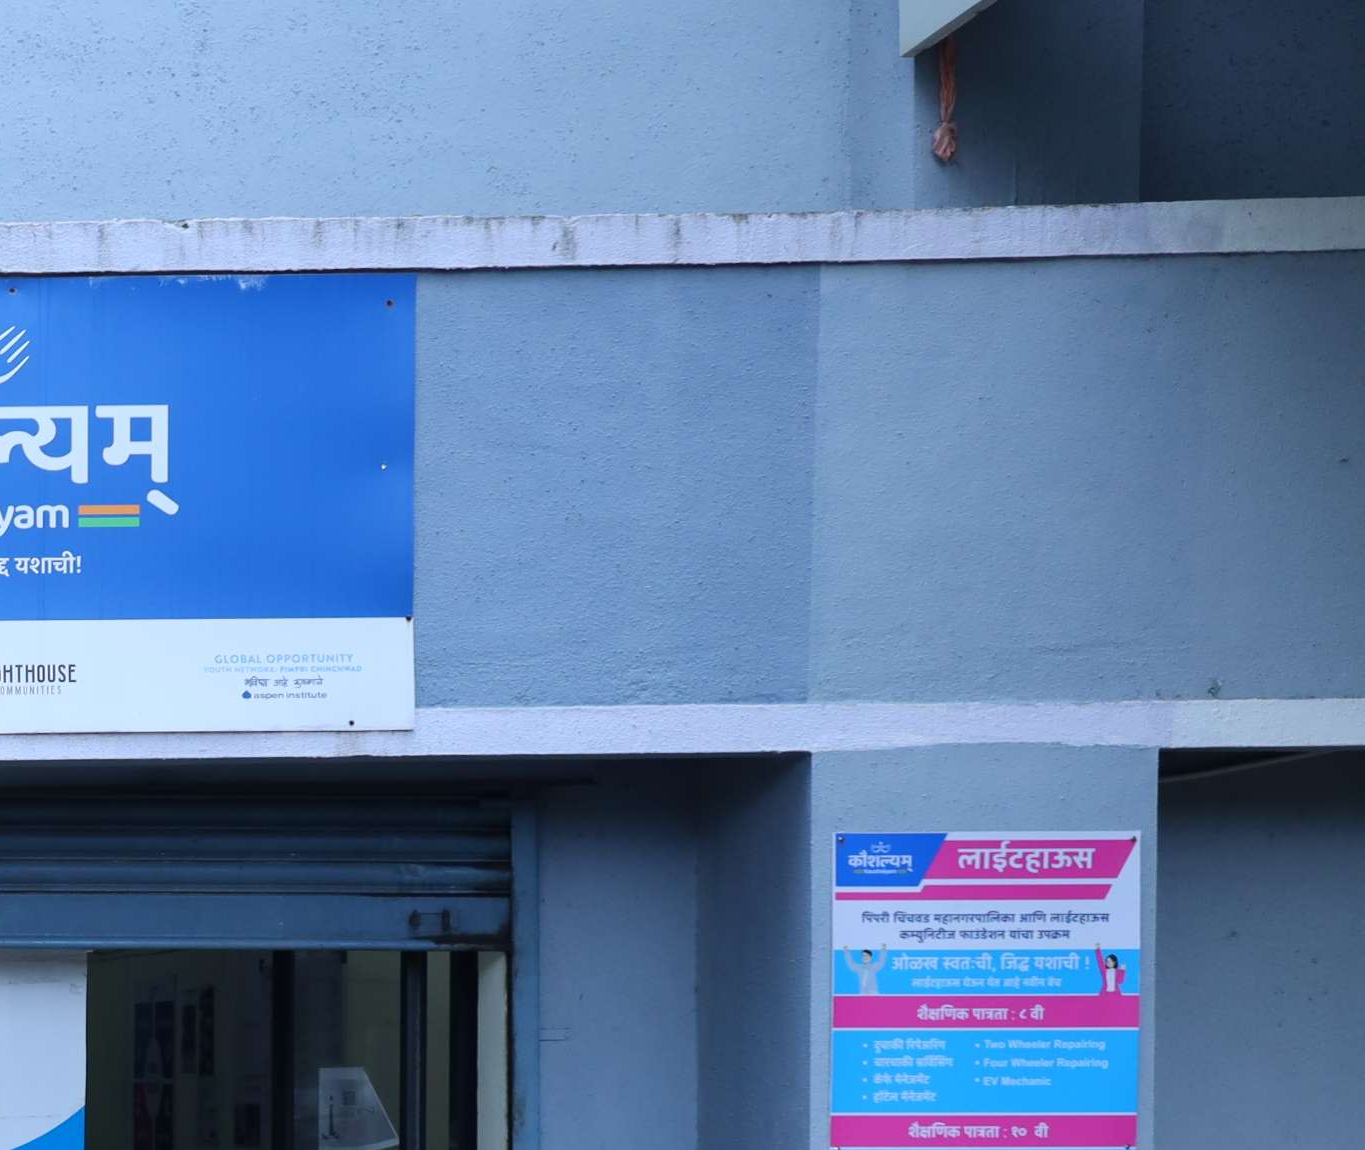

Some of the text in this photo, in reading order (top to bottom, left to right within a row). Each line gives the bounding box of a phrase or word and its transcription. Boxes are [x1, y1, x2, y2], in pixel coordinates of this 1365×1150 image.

[14, 551, 81, 574] यशाची!
[213, 653, 353, 664] GLOBAL OPPORTUNITY
